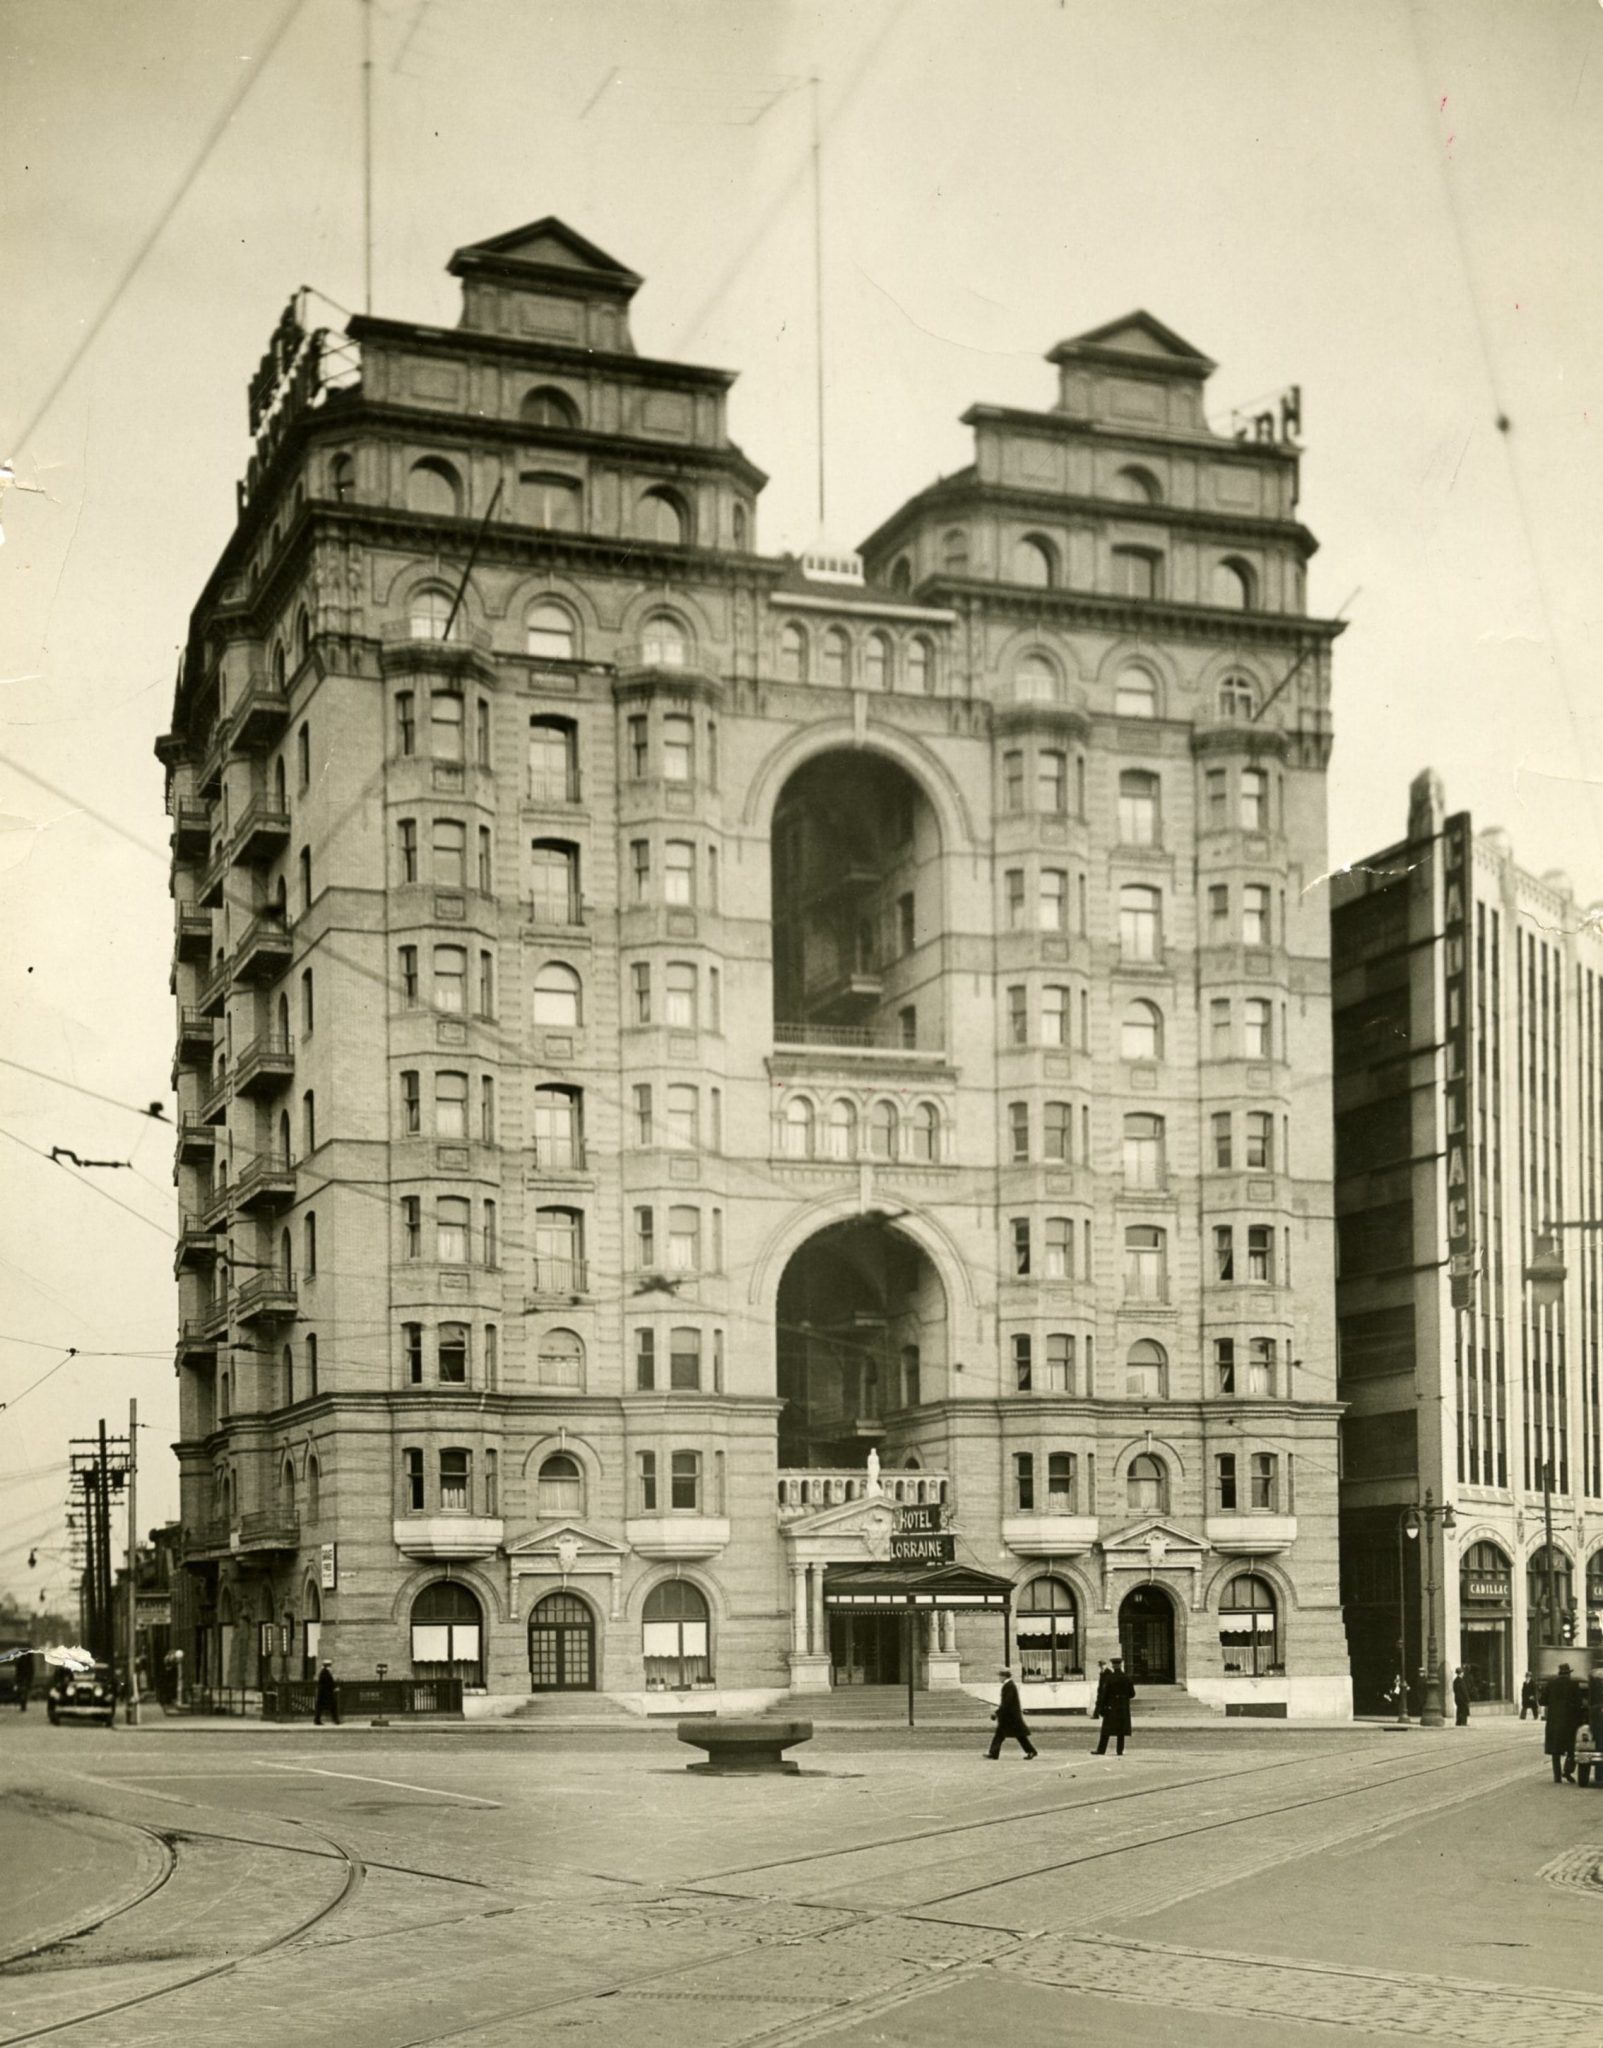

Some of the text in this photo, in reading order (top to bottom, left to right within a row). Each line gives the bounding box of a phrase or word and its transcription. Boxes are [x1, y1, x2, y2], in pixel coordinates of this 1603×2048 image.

[1444, 828, 1467, 1239] CADILLAC
[900, 1509, 933, 1529] HOTEL
[890, 1540, 943, 1558] LORRAINE
[1470, 1584, 1508, 1594] CADILLAC
